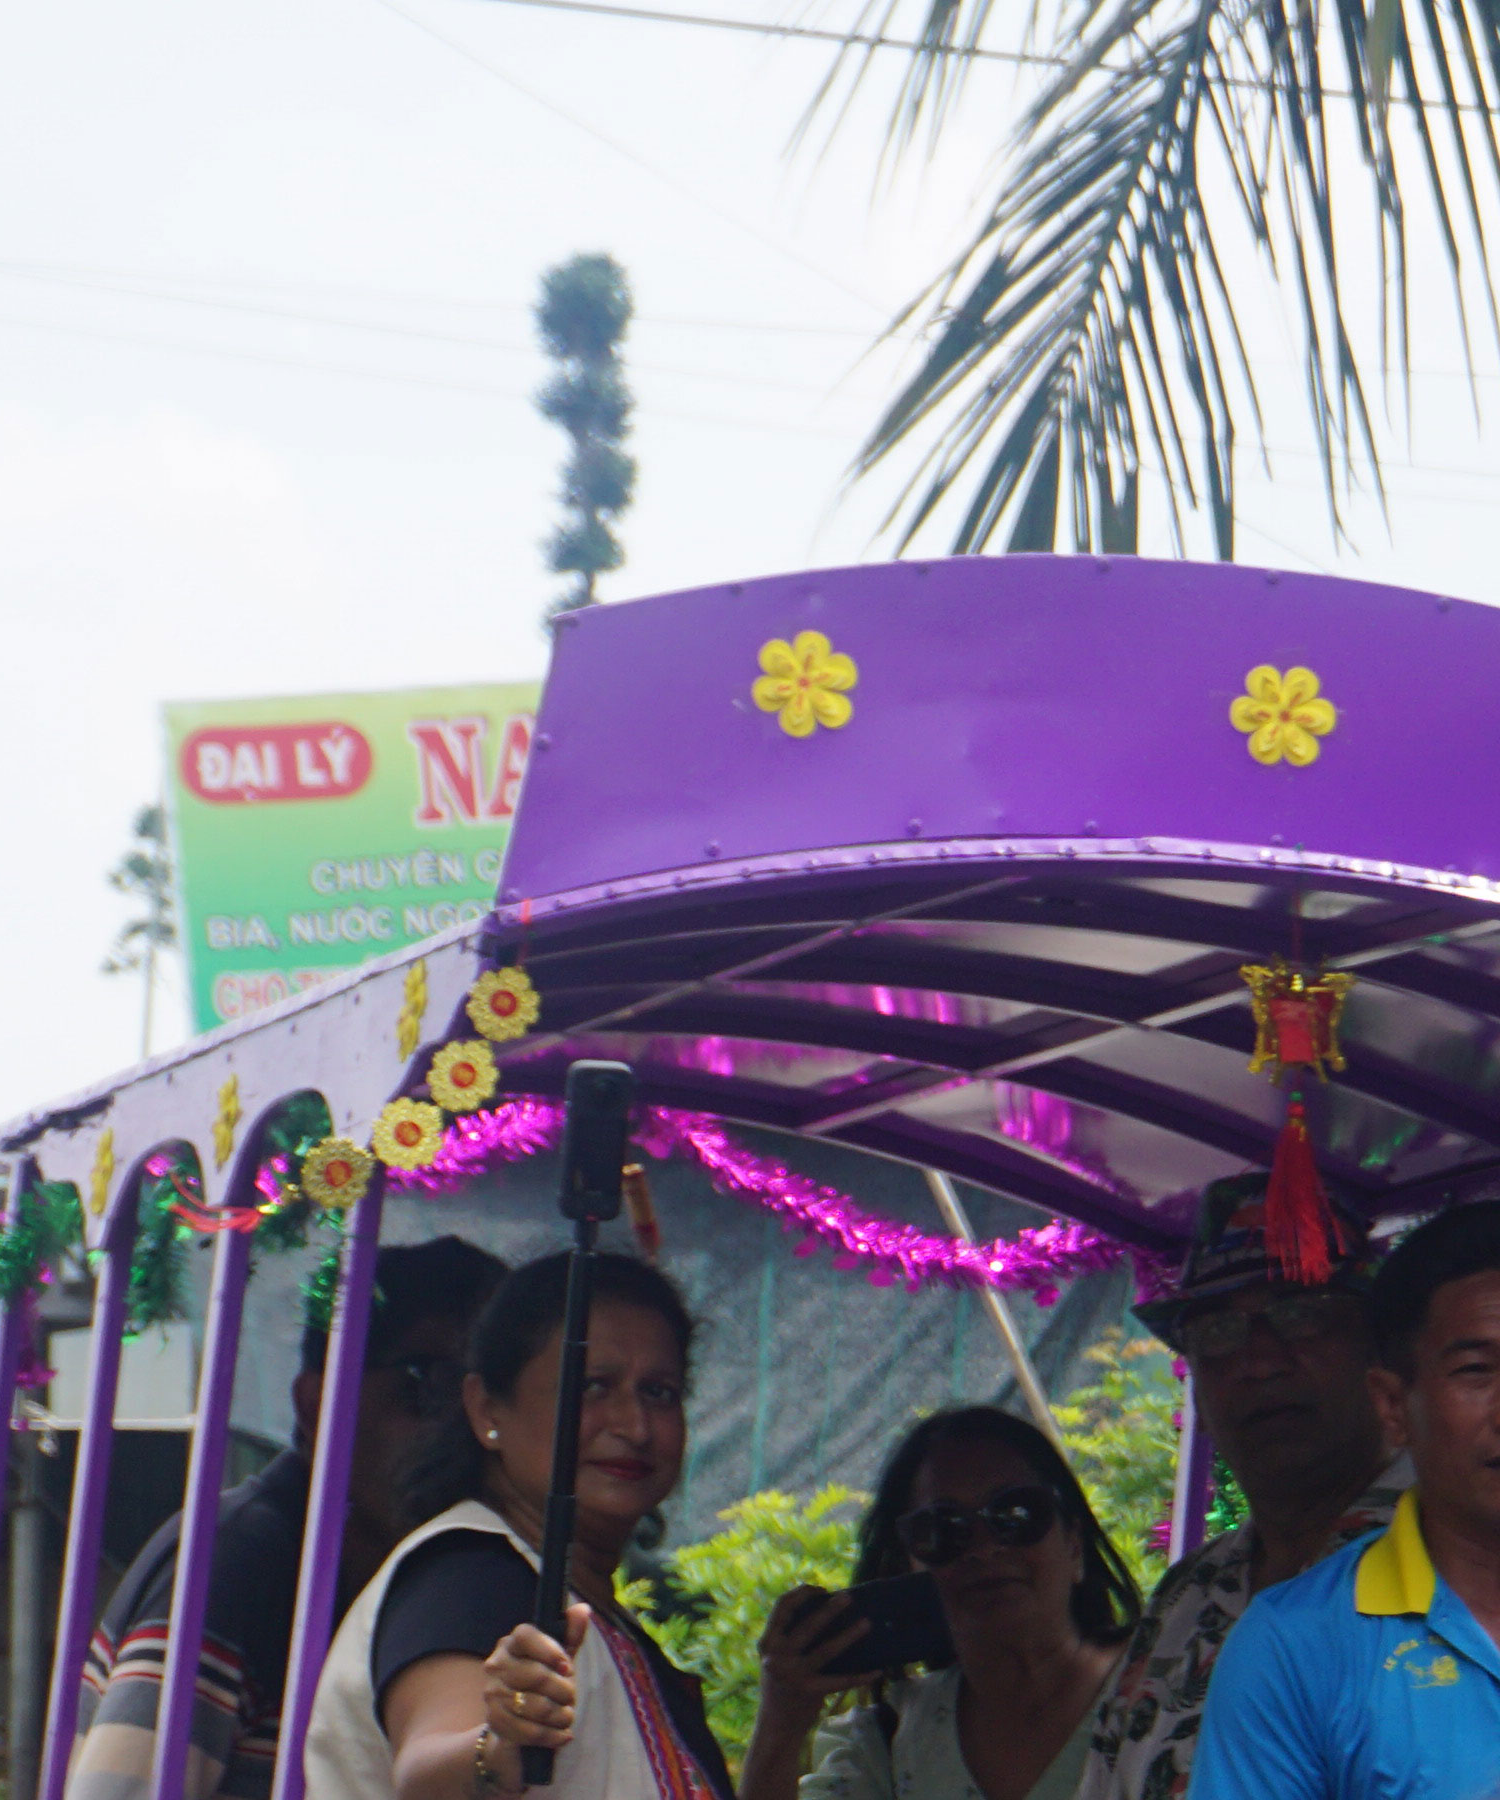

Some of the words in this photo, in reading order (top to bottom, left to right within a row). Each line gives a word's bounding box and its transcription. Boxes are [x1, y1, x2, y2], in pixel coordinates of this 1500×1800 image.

[198, 741, 281, 801] ĐẠI
[296, 726, 356, 785] LÝ
[409, 712, 536, 828] NA
[310, 849, 466, 895] CHUYÊN
